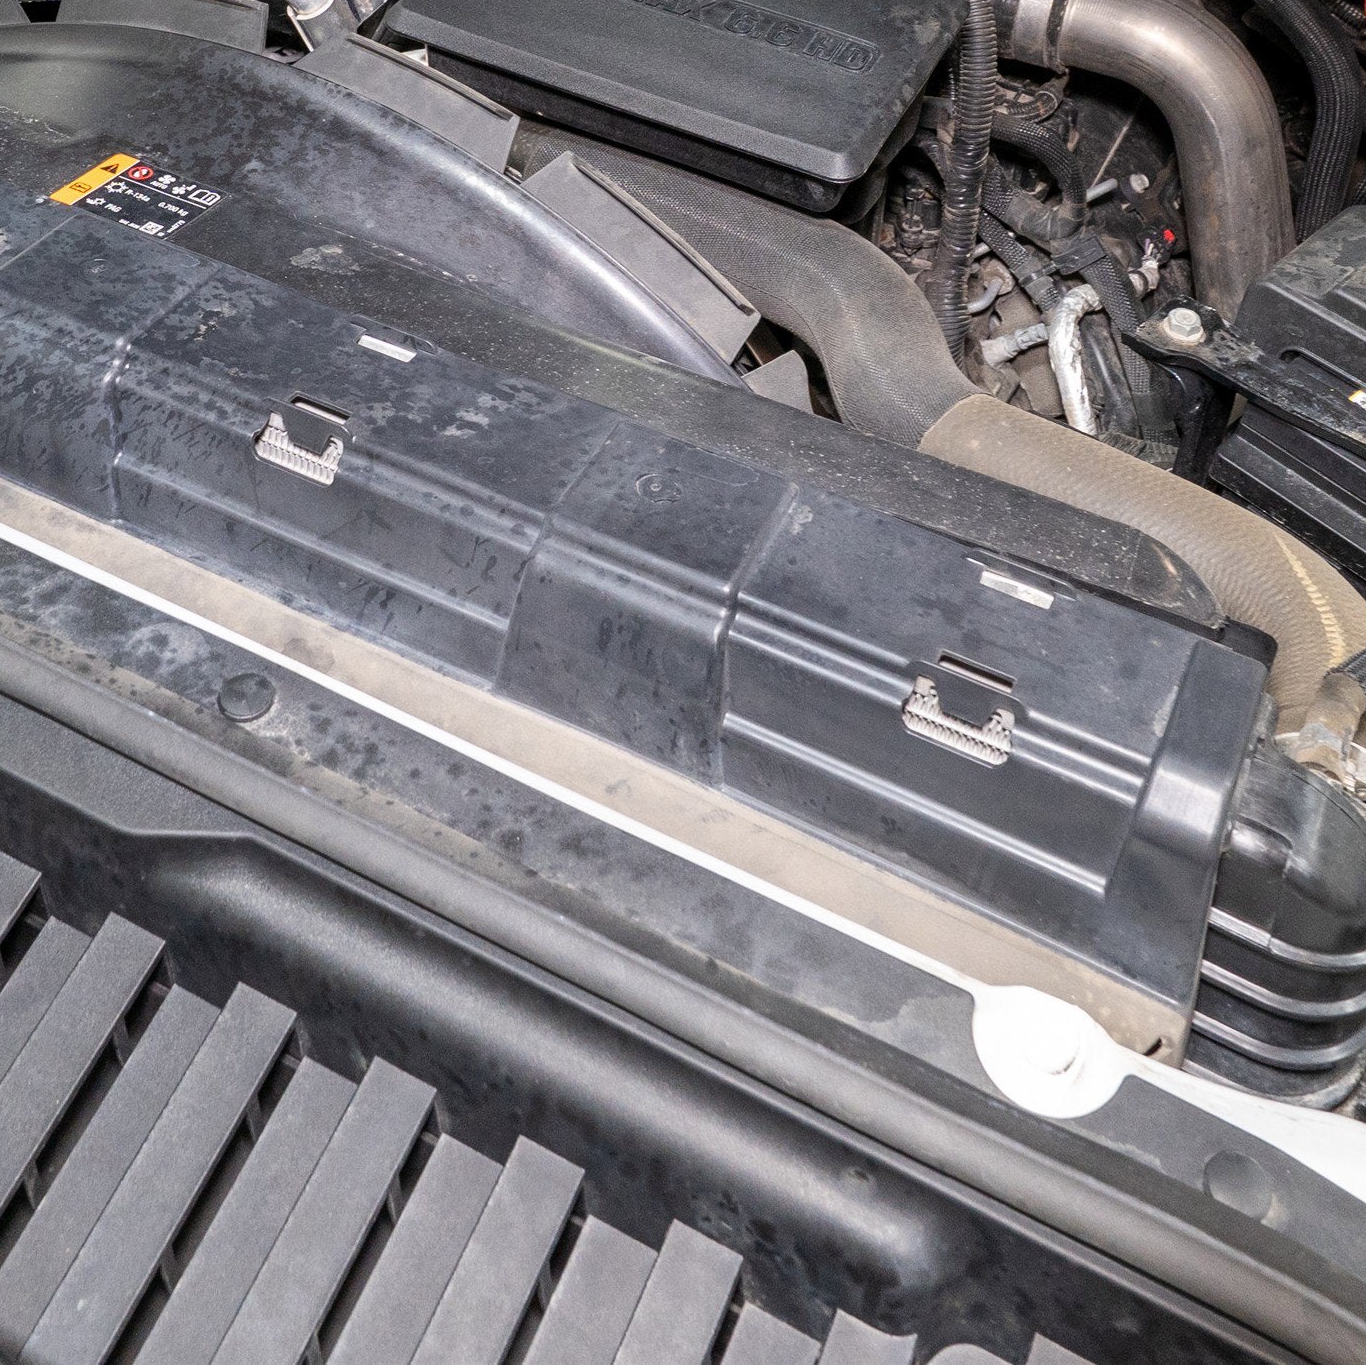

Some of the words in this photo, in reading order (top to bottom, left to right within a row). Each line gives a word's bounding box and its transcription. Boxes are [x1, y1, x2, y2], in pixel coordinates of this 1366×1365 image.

[723, 5, 803, 47] 6.6
[803, 28, 881, 73] HD
[104, 203, 122, 213] PAG
